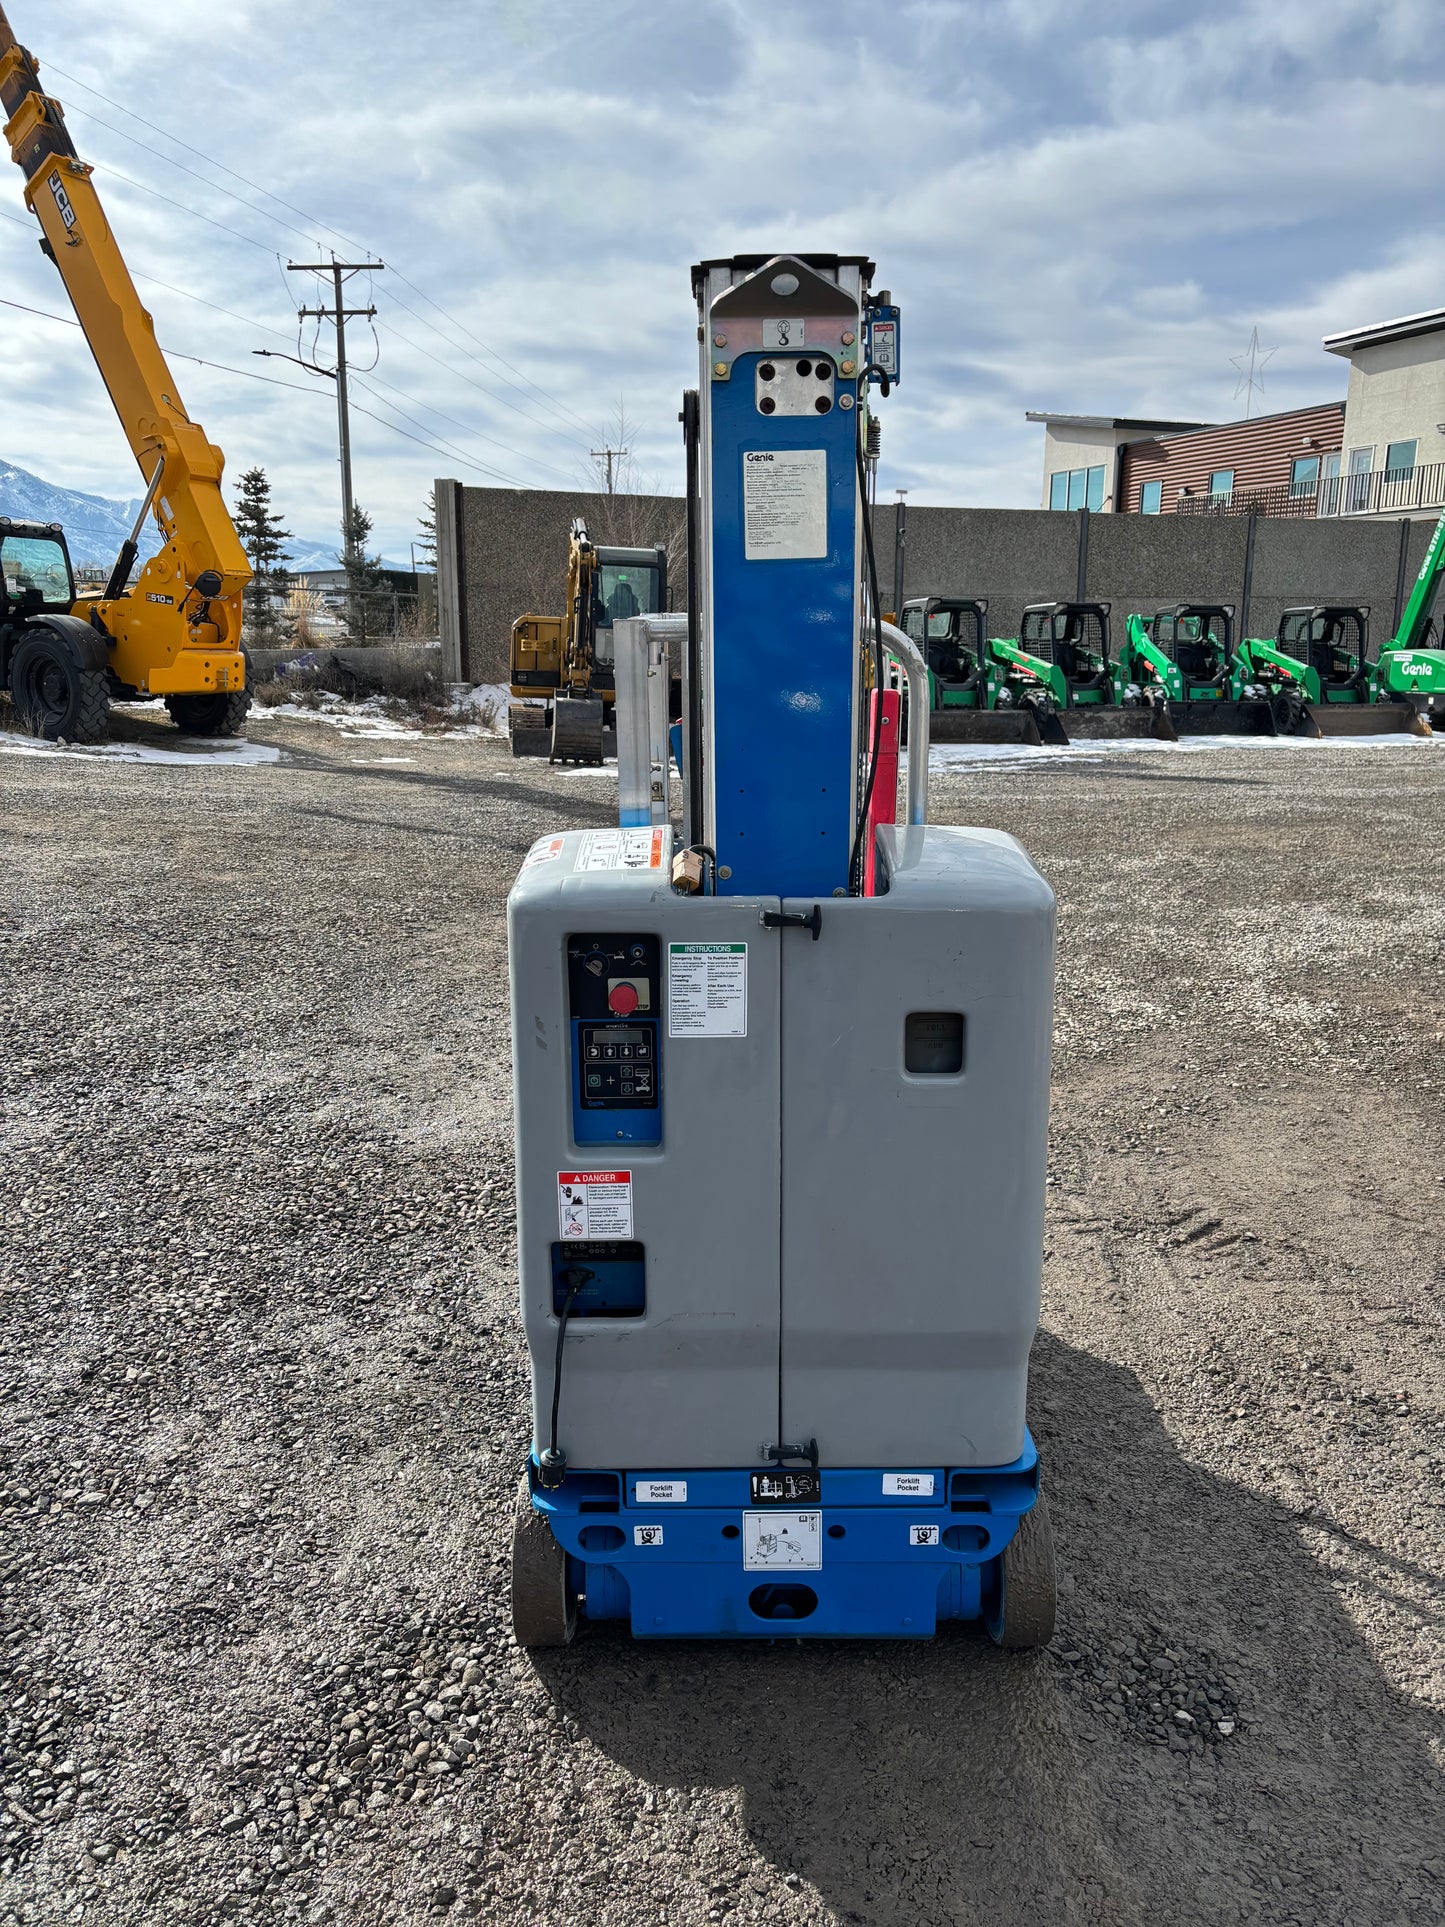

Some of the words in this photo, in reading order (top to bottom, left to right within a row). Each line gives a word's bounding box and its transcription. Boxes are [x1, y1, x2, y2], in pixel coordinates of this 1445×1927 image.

[49, 175, 76, 228] JCB
[746, 452, 775, 462] Genie
[1418, 554, 1433, 580] Genie
[151, 593, 166, 603] 510
[1401, 661, 1433, 676] Genie
[684, 945, 732, 953] INSTRUCTIONS
[582, 1174, 616, 1183] DANGER
